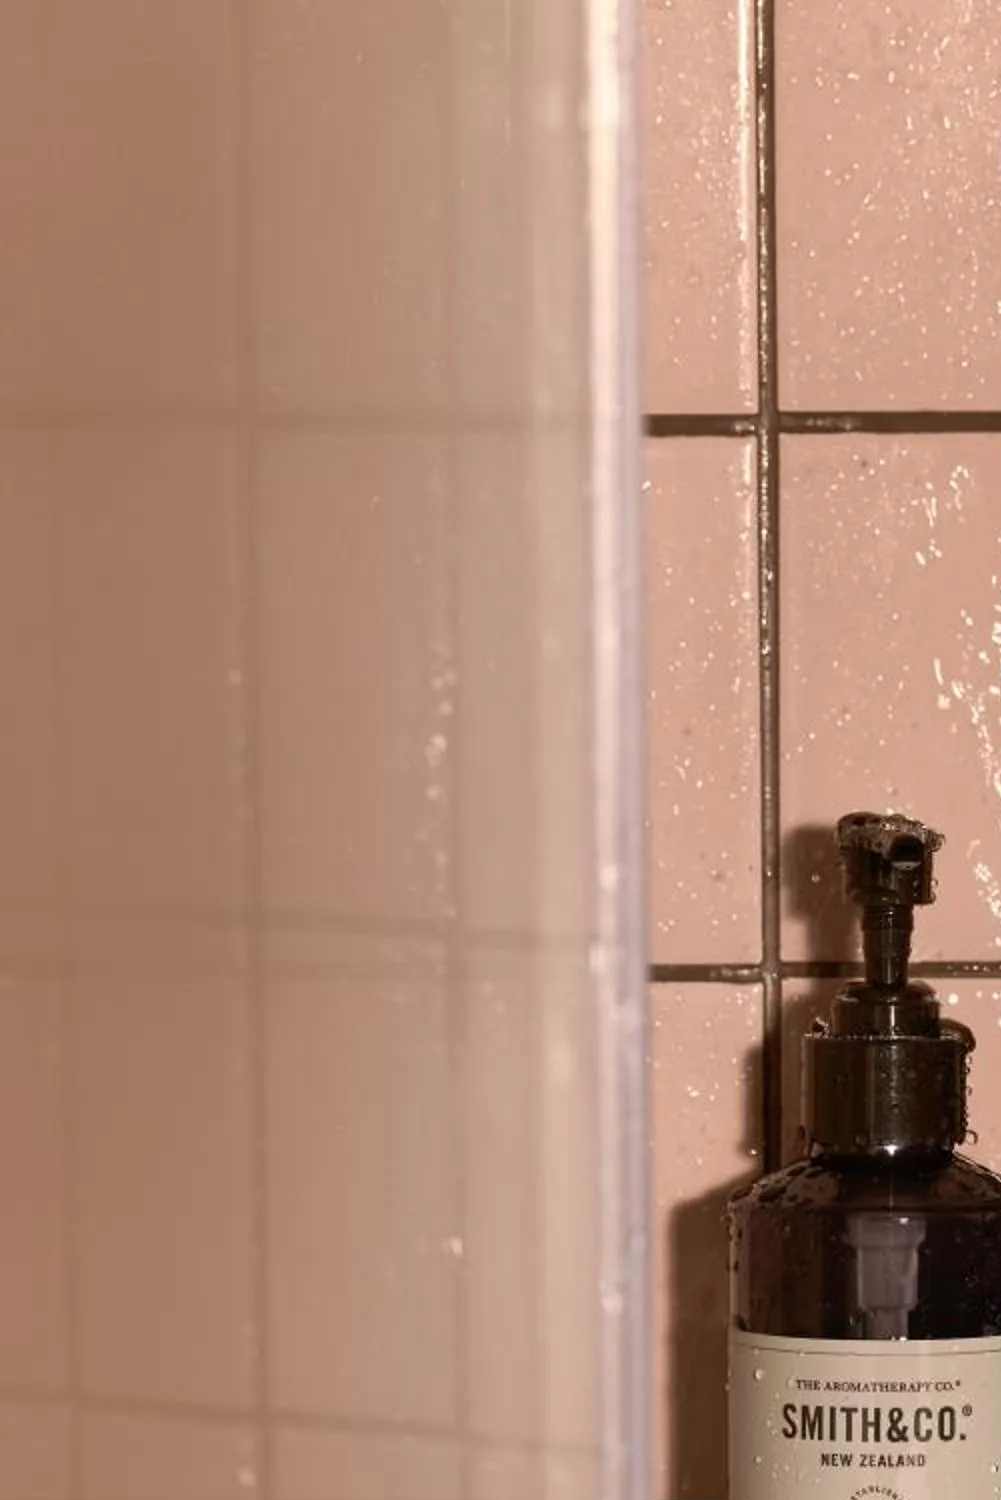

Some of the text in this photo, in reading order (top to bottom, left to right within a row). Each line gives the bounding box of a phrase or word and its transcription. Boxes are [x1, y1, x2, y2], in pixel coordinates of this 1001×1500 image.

[796, 1380, 821, 1391] THE
[824, 1380, 931, 1393] AROMATHERAPY
[821, 1453, 926, 1468] NEW ZEALAND
